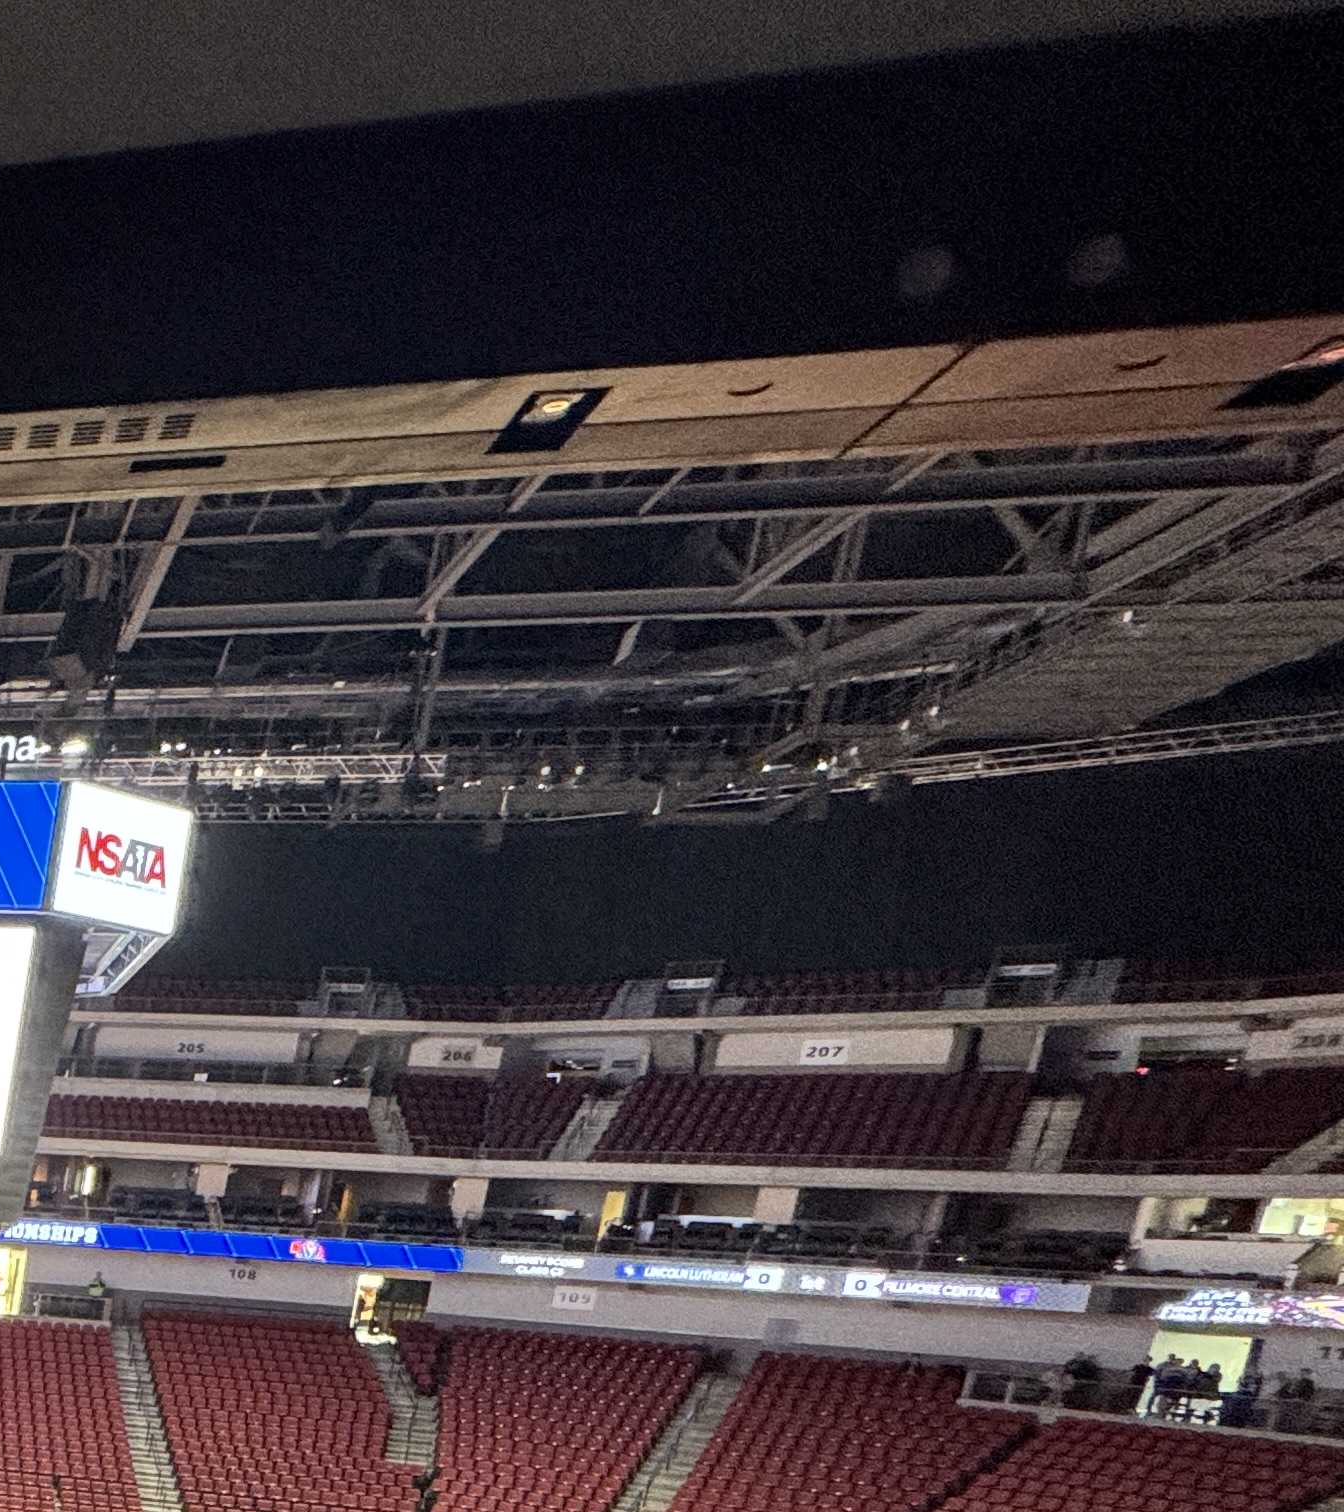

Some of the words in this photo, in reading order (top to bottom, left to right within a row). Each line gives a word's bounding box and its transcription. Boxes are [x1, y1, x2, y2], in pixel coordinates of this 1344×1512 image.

[75, 826, 166, 889] NSATA
[177, 1042, 205, 1054] 205
[805, 1045, 844, 1059] 207
[442, 1049, 472, 1062] 206
[6, 1223, 98, 1244] ONSHIPS
[228, 1268, 257, 1281] 108
[643, 1265, 688, 1281] LINCOLN
[758, 1273, 770, 1285] 0
[854, 1279, 867, 1292] 0
